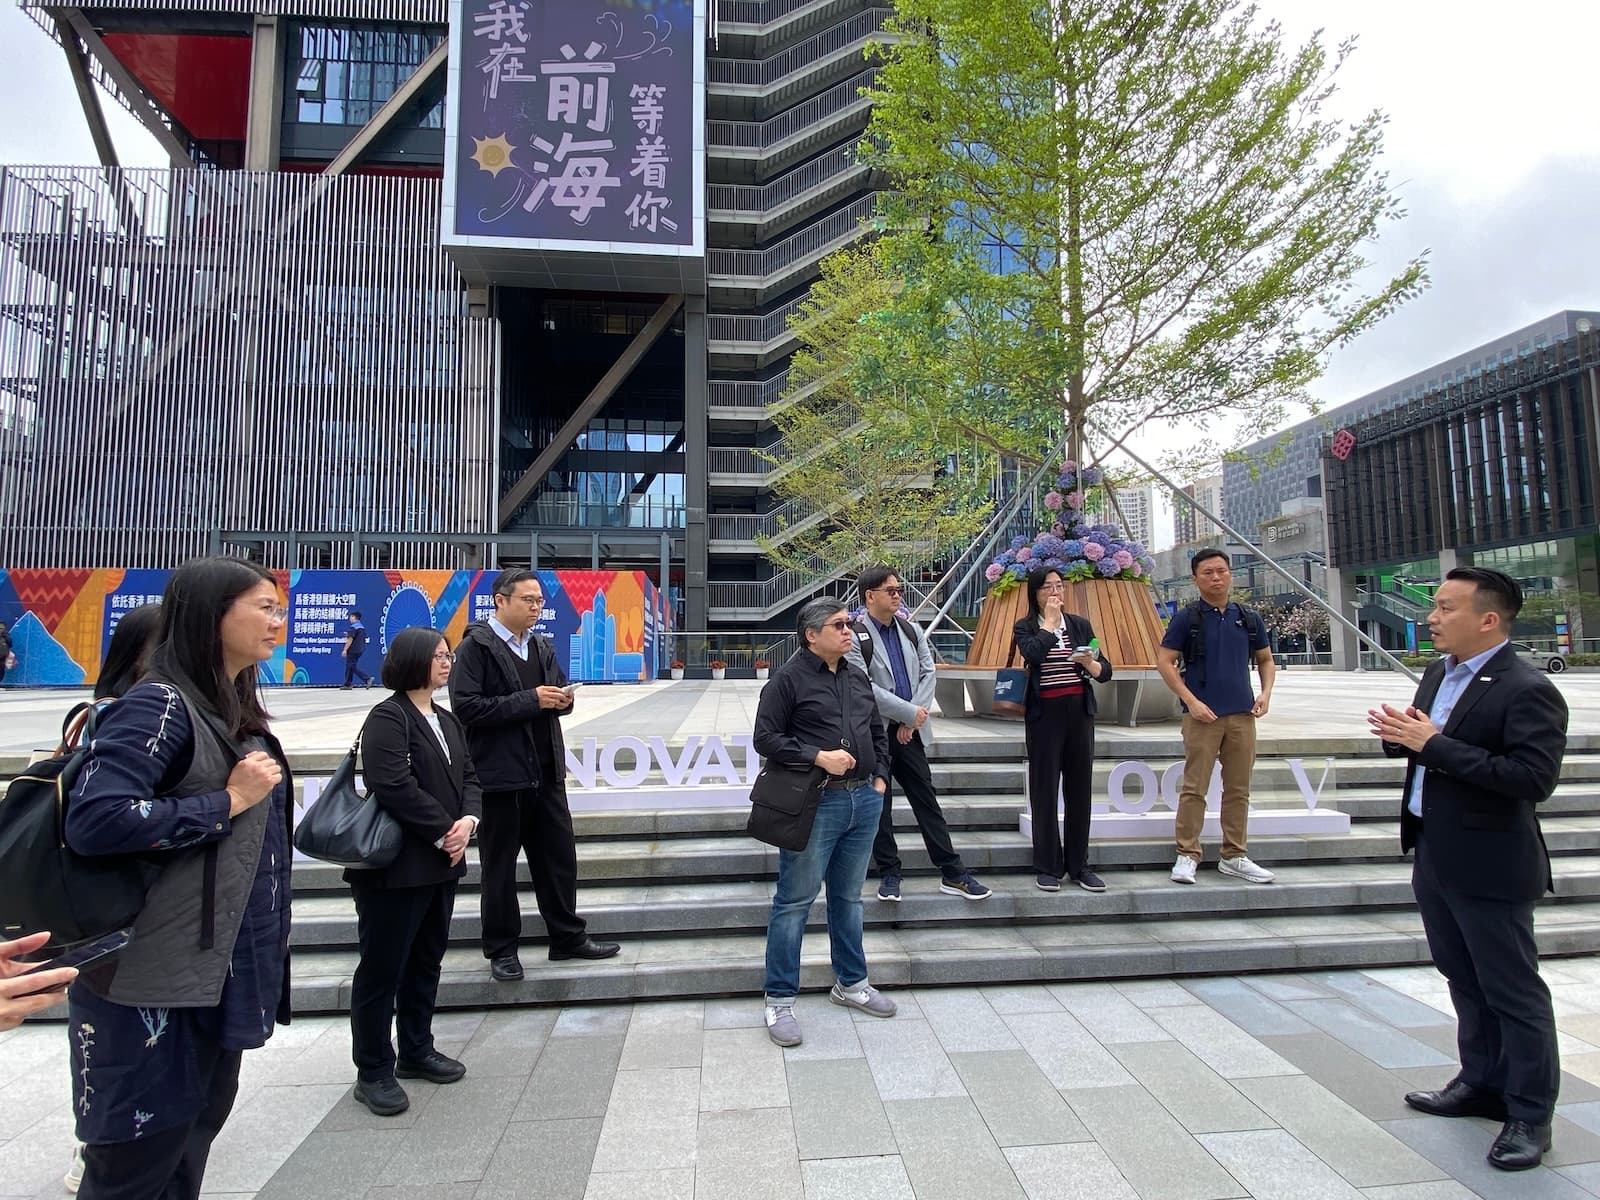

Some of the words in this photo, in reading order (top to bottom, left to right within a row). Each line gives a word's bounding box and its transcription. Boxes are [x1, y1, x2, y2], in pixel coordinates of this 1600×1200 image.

[473, 0, 537, 100] 我在
[522, 41, 622, 222] 前海
[625, 83, 678, 232] 等着你
